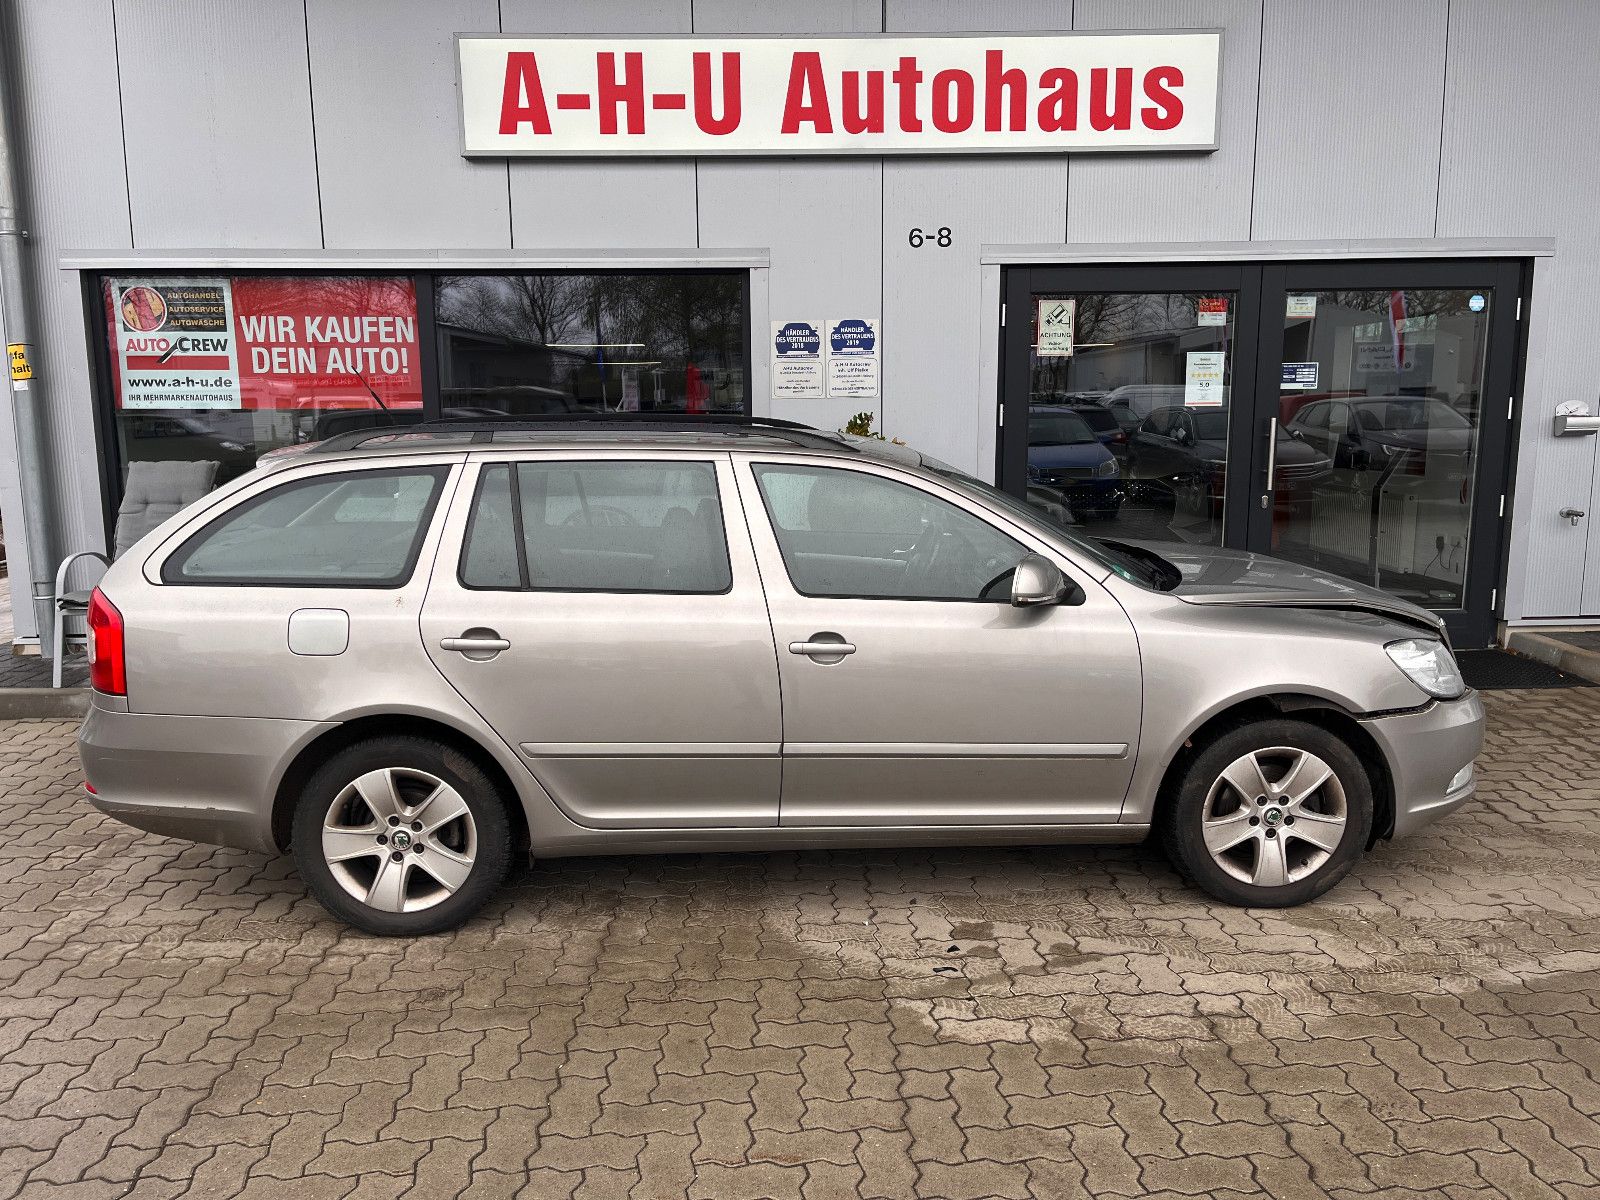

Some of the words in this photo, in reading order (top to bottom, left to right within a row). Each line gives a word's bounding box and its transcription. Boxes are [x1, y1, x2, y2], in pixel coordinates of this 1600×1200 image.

[499, 51, 742, 136] A-H-U
[780, 49, 1185, 135] Autohaus
[908, 226, 952, 248] 6-8
[167, 291, 222, 299] AUTOHANDEL
[168, 305, 224, 313] AUTOSERVICE
[170, 317, 225, 326] AUTOWÄSCHE
[239, 315, 297, 343] WIR
[304, 316, 414, 343] KAUFEN
[126, 338, 171, 352] AUTO
[177, 337, 229, 353] CREW
[251, 347, 317, 374] DEIN
[326, 347, 409, 375] AUTO!
[128, 376, 233, 388] www.a-h-u.de
[128, 394, 141, 402] IHR
[143, 394, 233, 402] MEHRMARKENAUTOHAUS
